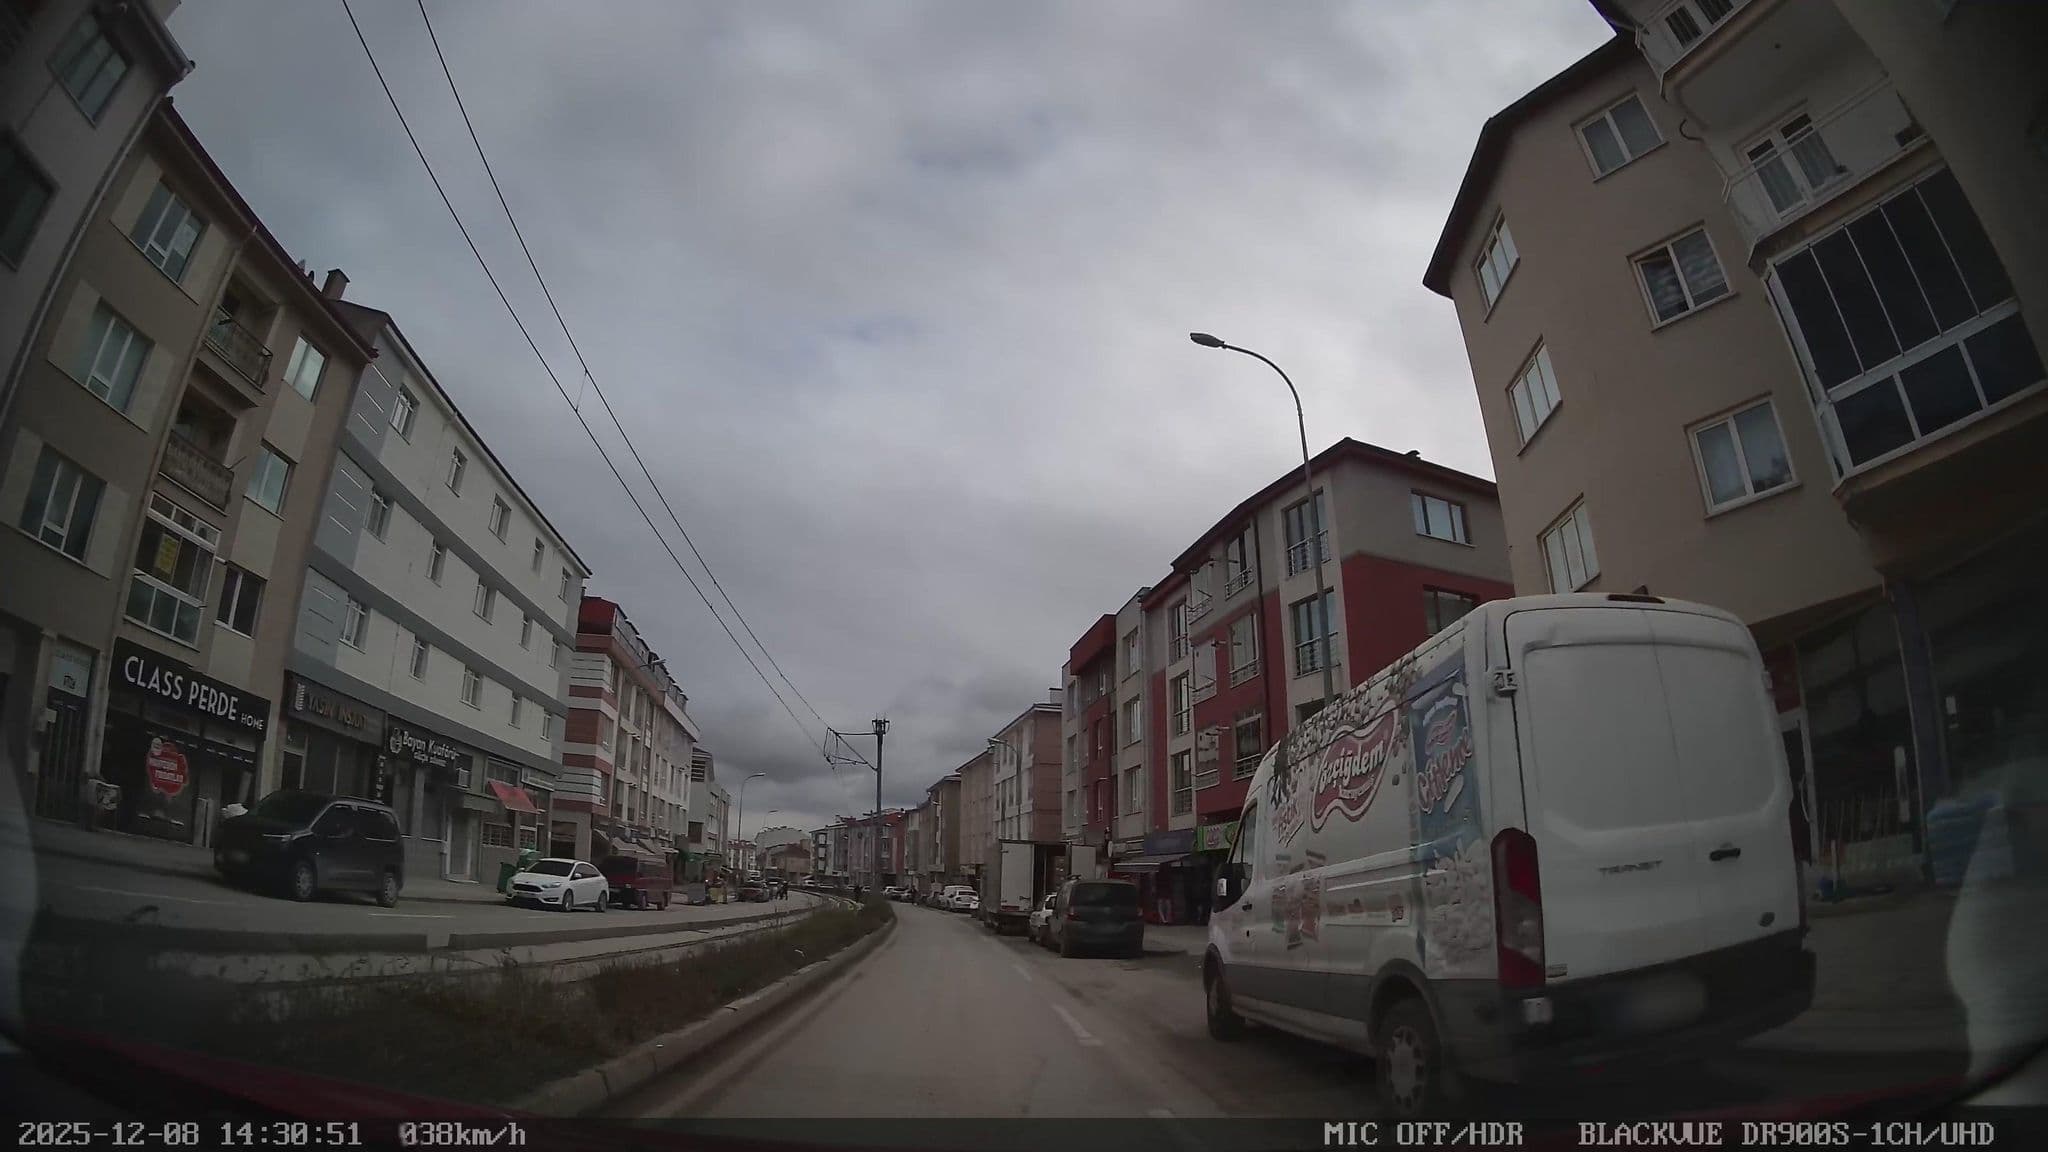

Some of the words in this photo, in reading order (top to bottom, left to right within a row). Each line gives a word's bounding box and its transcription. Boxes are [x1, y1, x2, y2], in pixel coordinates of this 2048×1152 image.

[124, 655, 184, 701] CLASS
[188, 681, 239, 721] PERDE
[241, 712, 265, 730] HOME
[402, 730, 426, 752] Bayan
